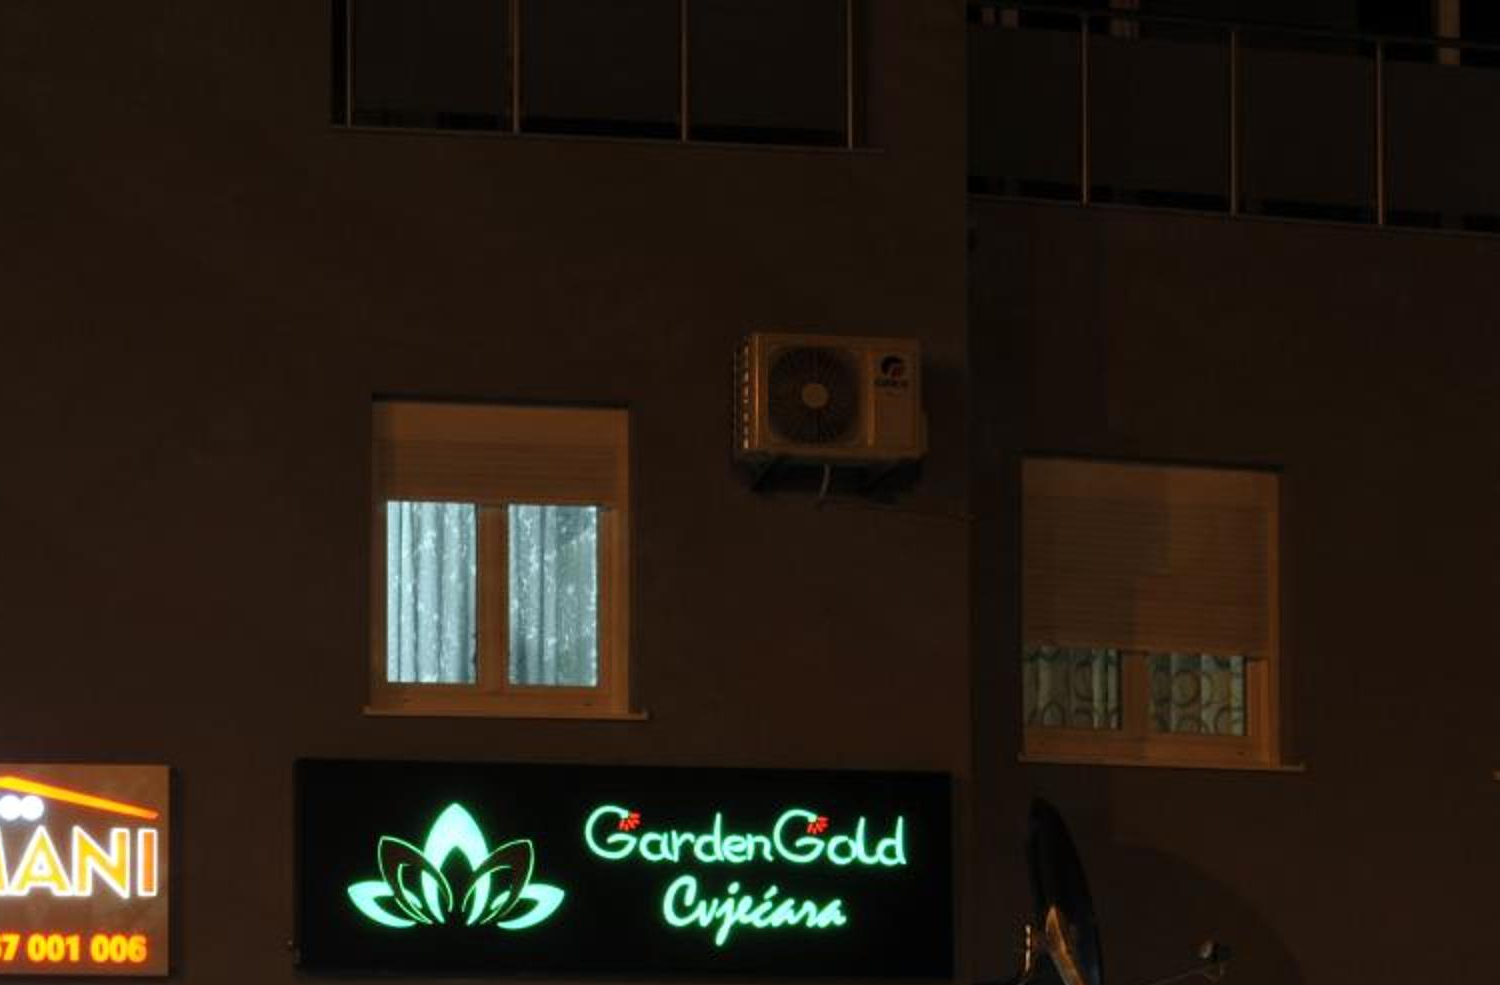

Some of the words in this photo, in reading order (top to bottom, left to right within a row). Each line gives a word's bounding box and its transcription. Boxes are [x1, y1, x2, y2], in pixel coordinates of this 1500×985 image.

[584, 805, 908, 865] GardenGold
[28, 934, 80, 962] 001
[91, 935, 147, 963] 006
